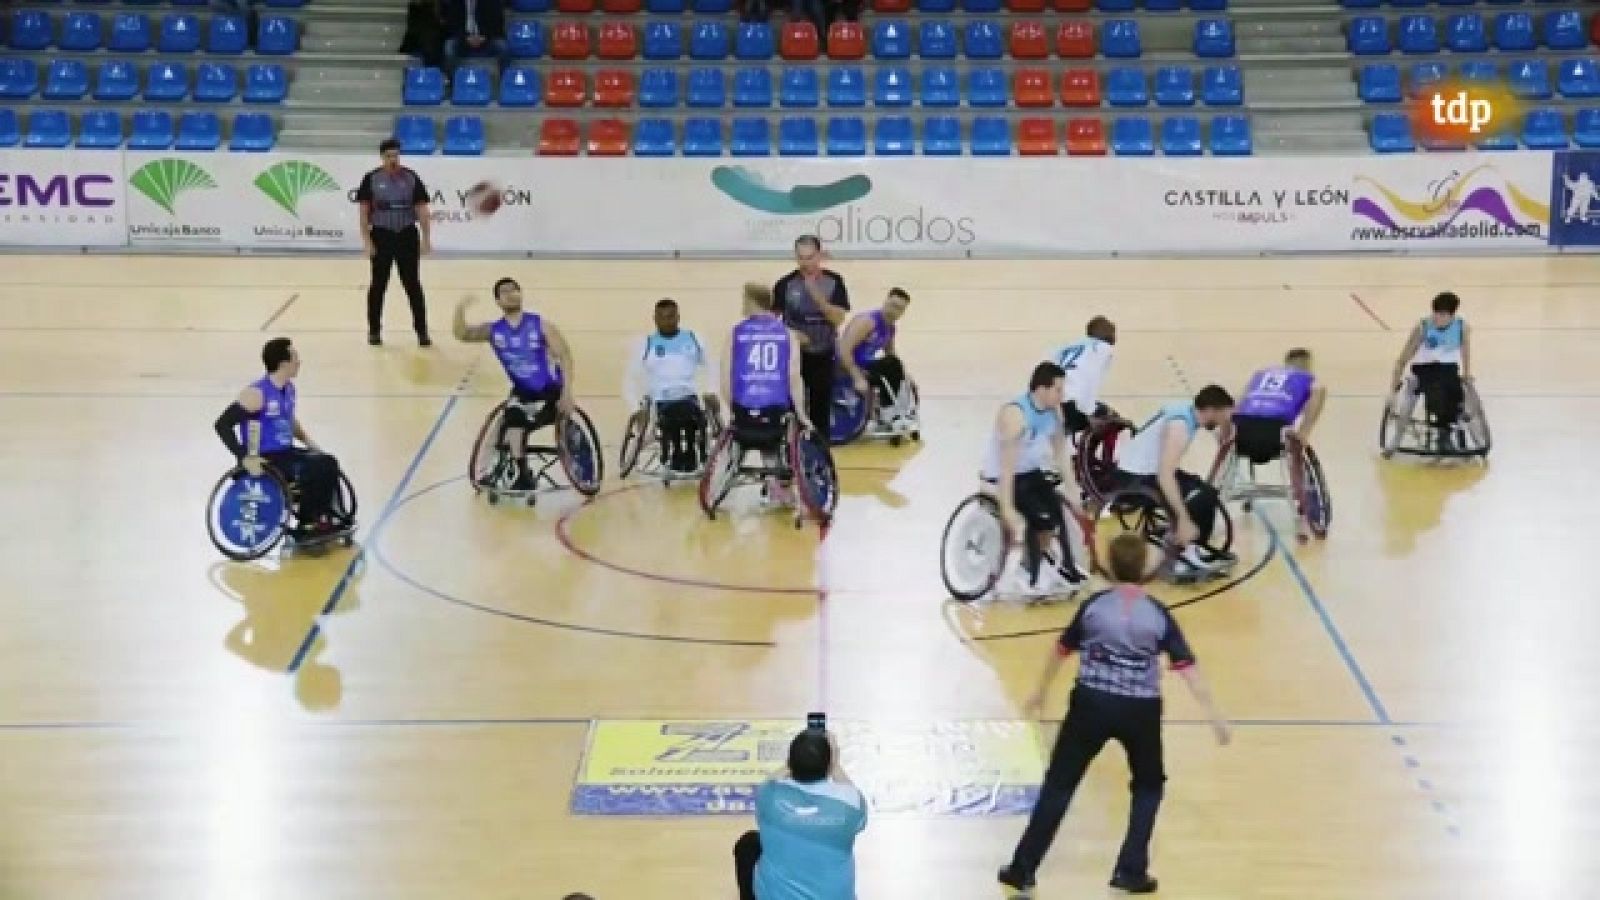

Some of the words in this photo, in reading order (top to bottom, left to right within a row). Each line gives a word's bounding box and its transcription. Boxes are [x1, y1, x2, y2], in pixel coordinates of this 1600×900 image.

[1163, 189, 1260, 206] CASTILLA
[1274, 189, 1286, 208] Y
[1294, 184, 1350, 206] LEÓN
[817, 205, 976, 245] aliados
[747, 342, 779, 371] 40
